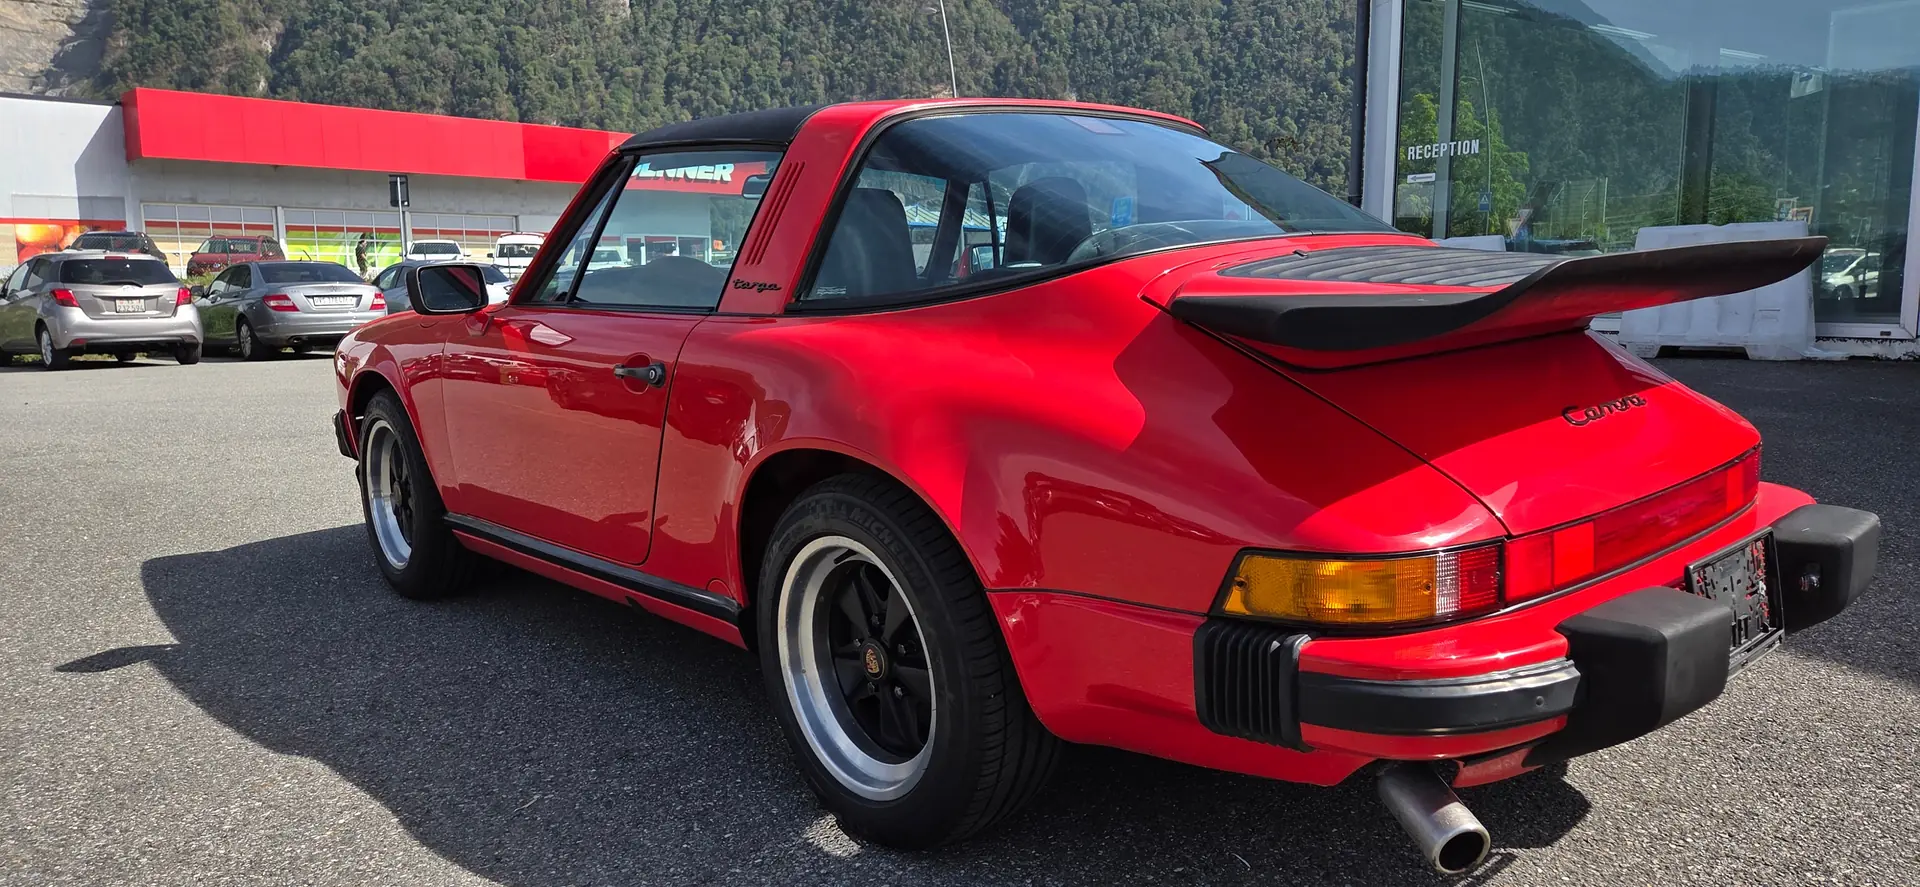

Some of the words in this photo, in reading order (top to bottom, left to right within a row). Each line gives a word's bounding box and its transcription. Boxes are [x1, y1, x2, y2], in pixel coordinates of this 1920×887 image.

[1408, 140, 1480, 161] RECEPTION
[732, 279, 782, 294] targa
[1561, 394, 1648, 426] Carrera
